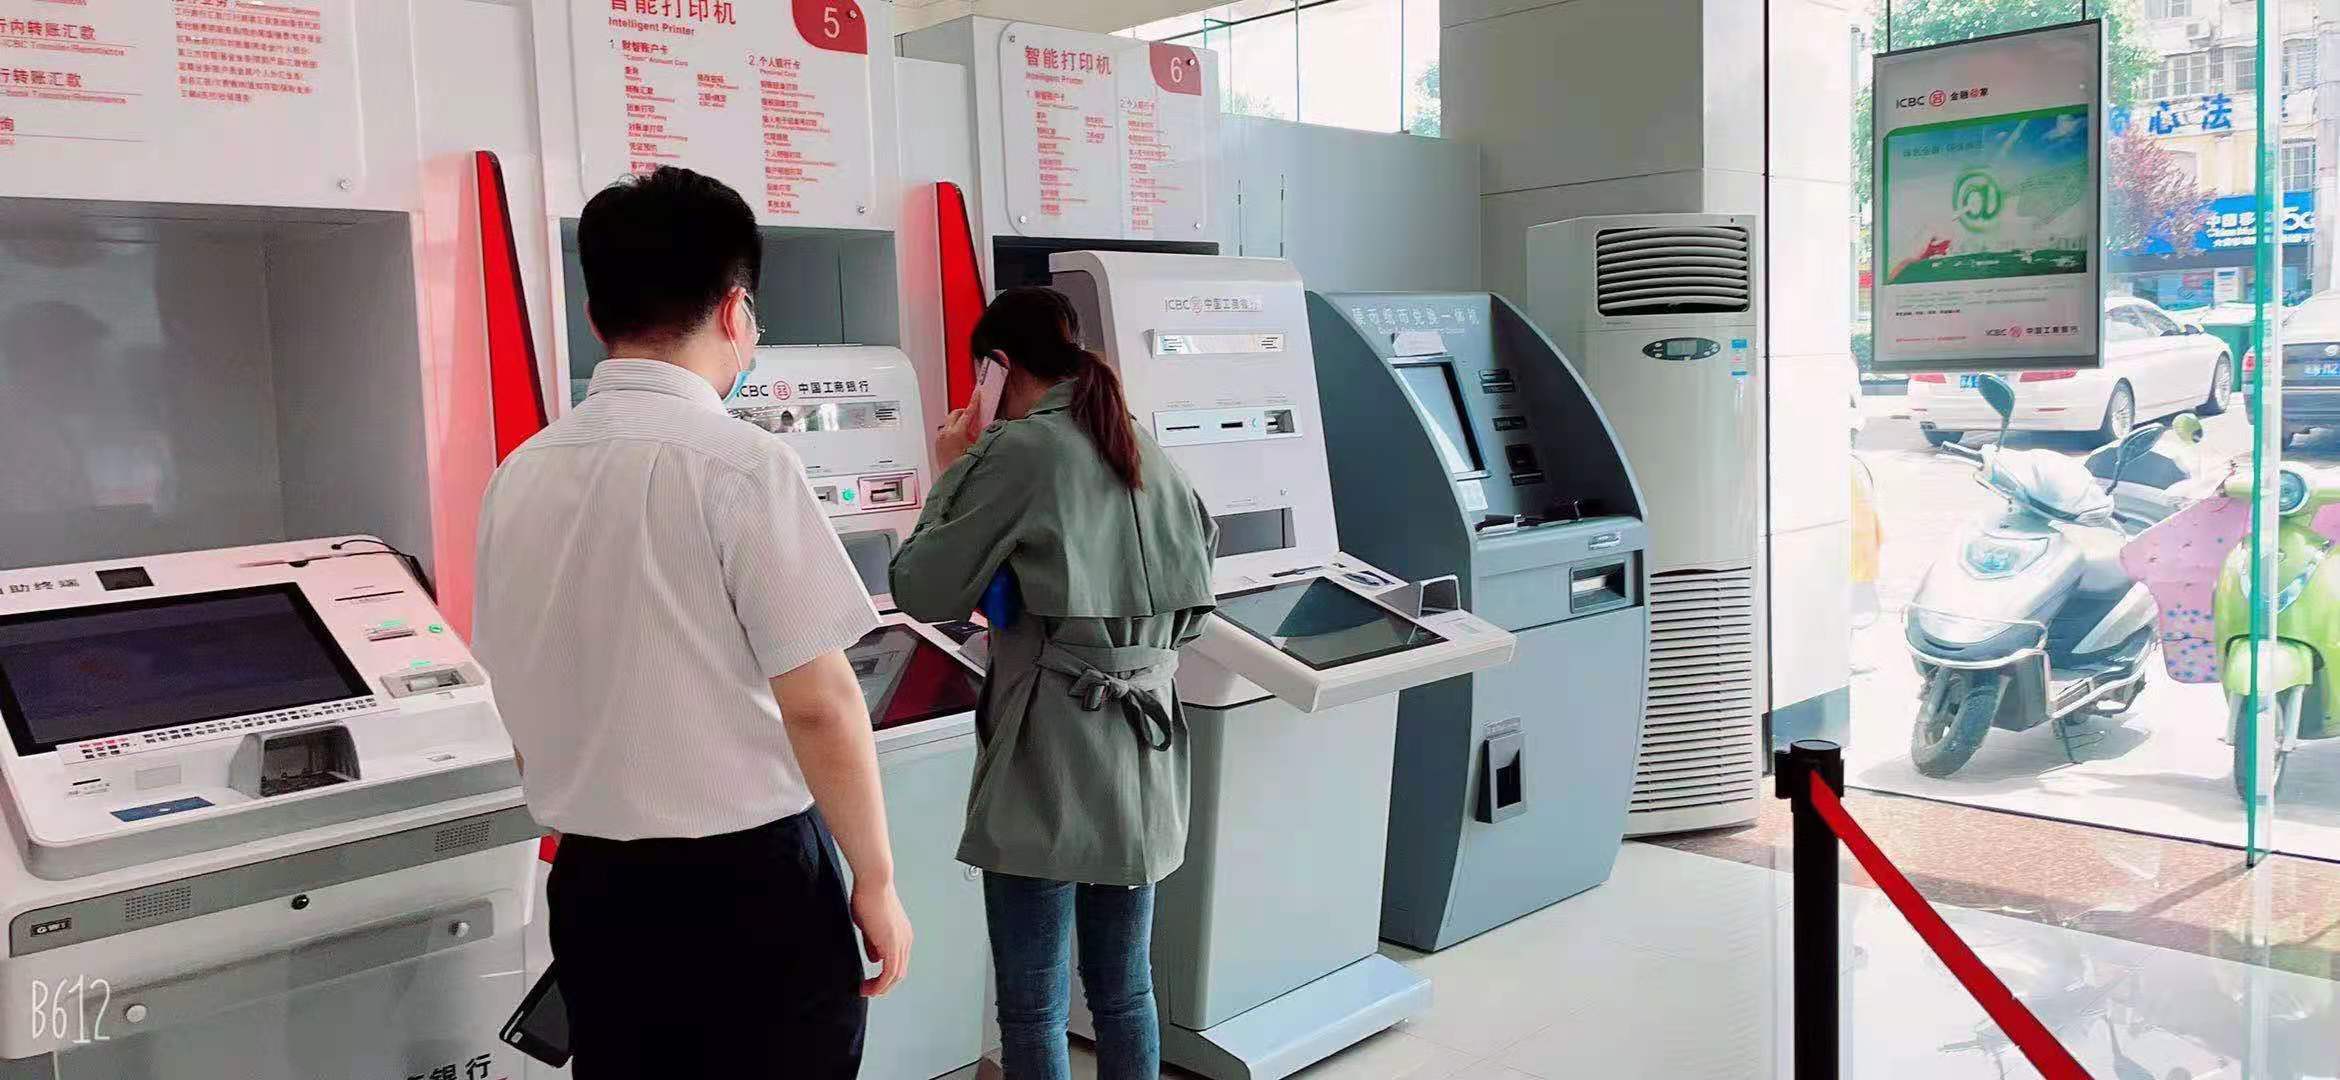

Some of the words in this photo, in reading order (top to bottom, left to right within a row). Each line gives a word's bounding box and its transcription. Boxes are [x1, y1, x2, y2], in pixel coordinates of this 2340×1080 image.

[608, 17, 659, 32] Intelligent
[661, 23, 695, 36] Printer
[823, 7, 841, 39] 5
[748, 54, 756, 66] 2
[759, 56, 800, 69] 个人银行卡
[1025, 45, 1112, 75] 智能打印机
[1170, 56, 1182, 83] 6
[1896, 96, 1925, 109] ICBC
[1164, 299, 1190, 311] ICBC
[798, 380, 870, 394] 中国工商银行
[0, 579, 80, 595] 助终端
[406, 1053, 493, 1080] 银行
